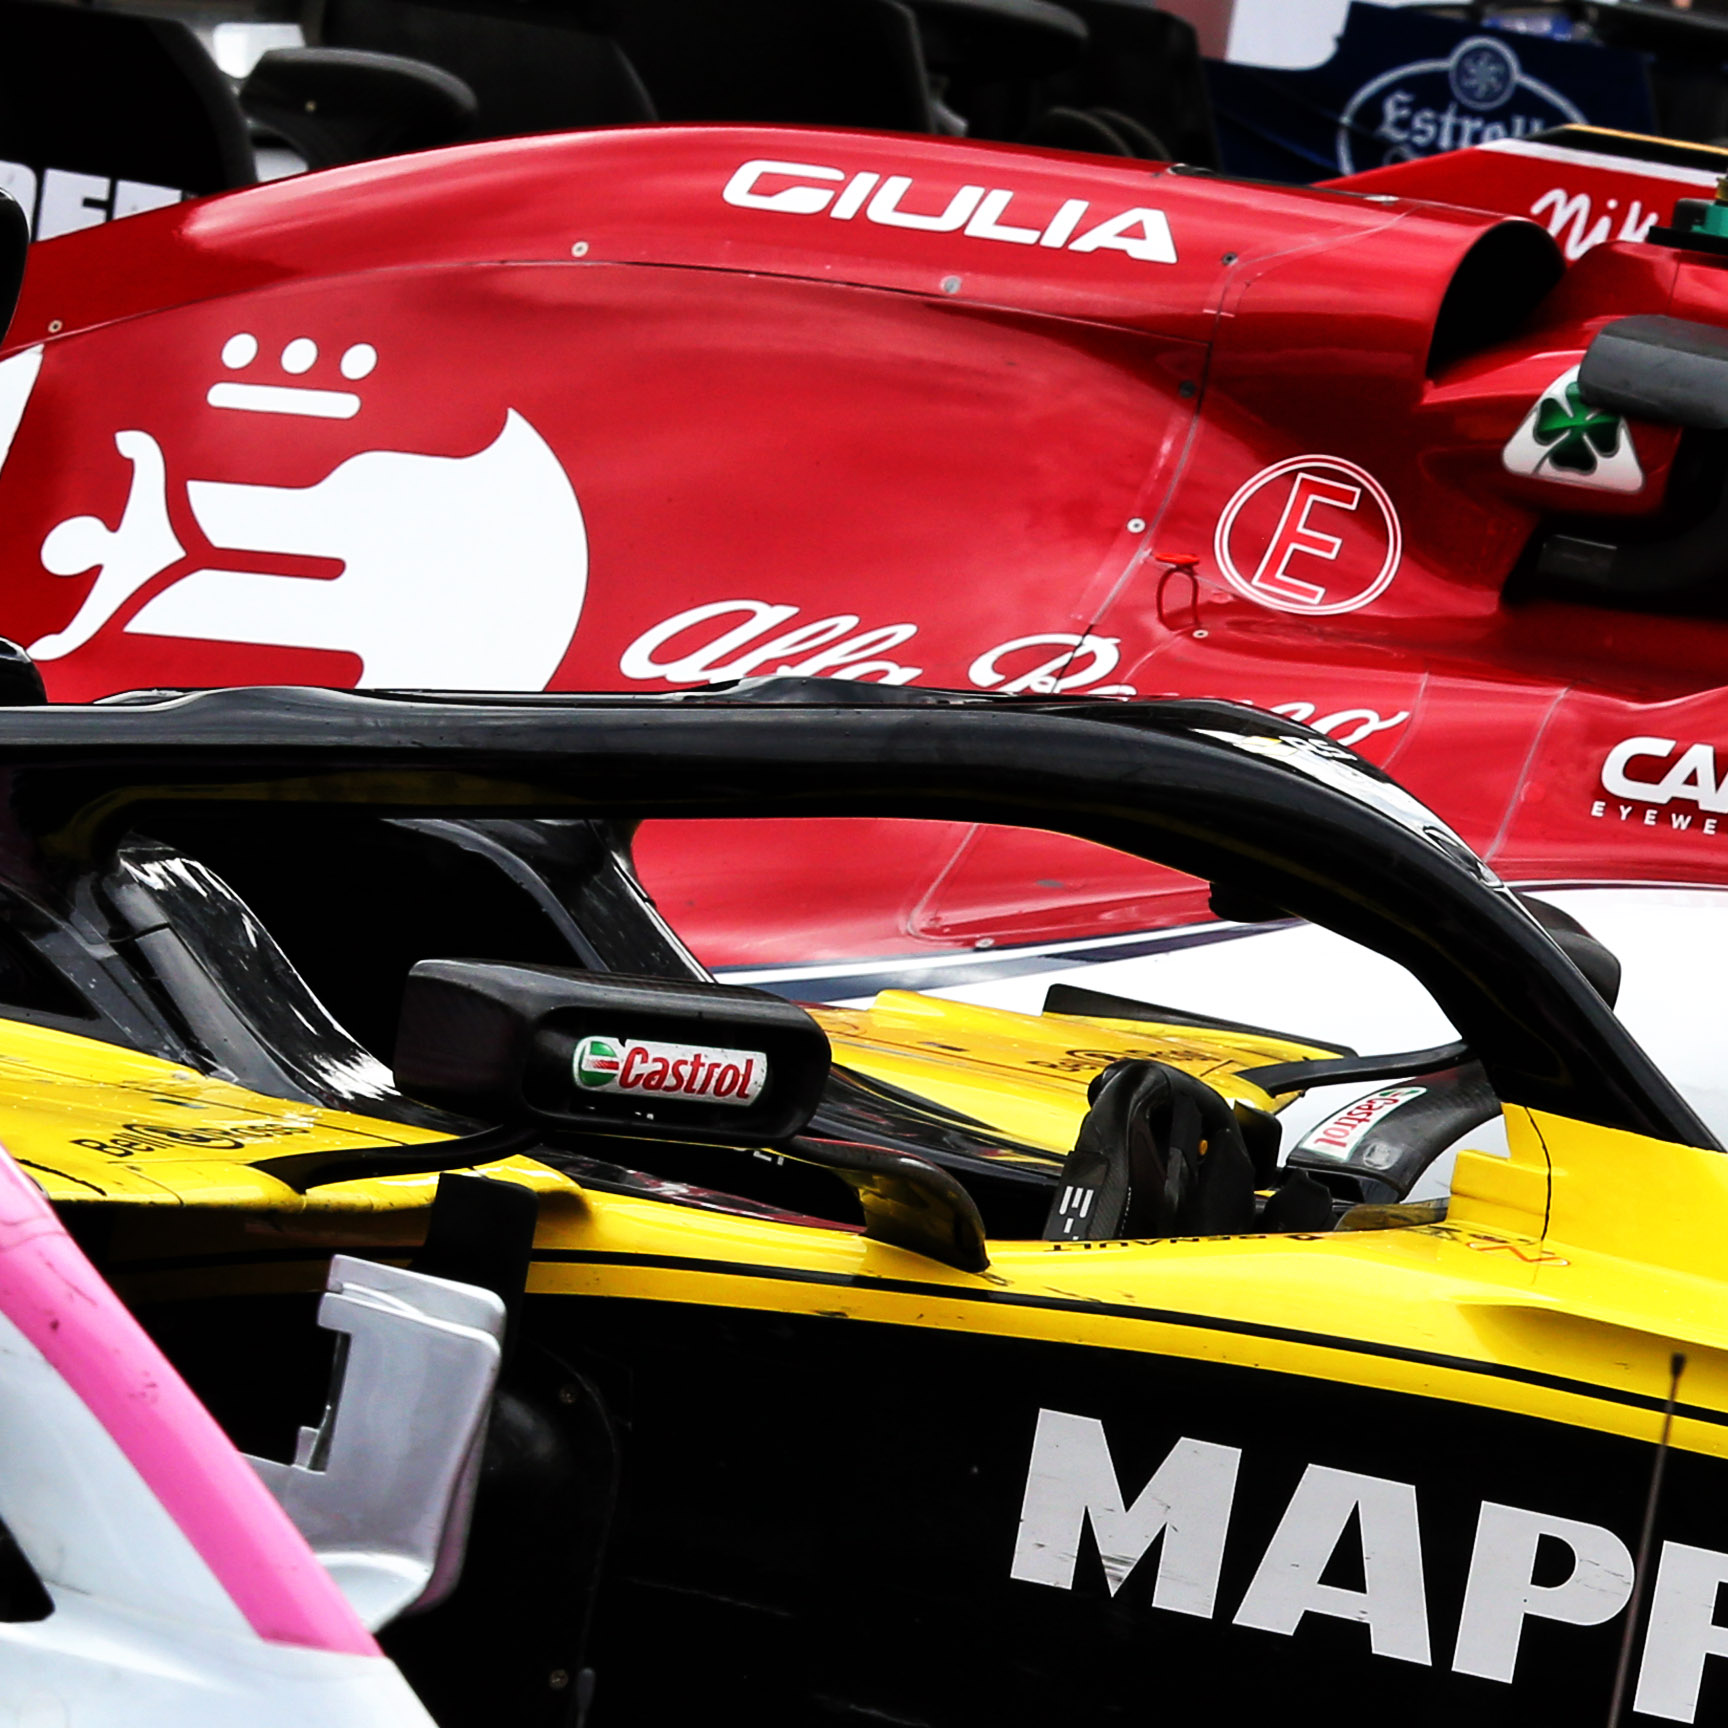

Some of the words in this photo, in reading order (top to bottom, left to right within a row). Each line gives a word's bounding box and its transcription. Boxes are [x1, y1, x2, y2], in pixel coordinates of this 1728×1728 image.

[722, 158, 1178, 265] GIULIA
[1252, 472, 1361, 606] E
[618, 1045, 755, 1101] Castrol
[1314, 1089, 1401, 1149] Castrol
